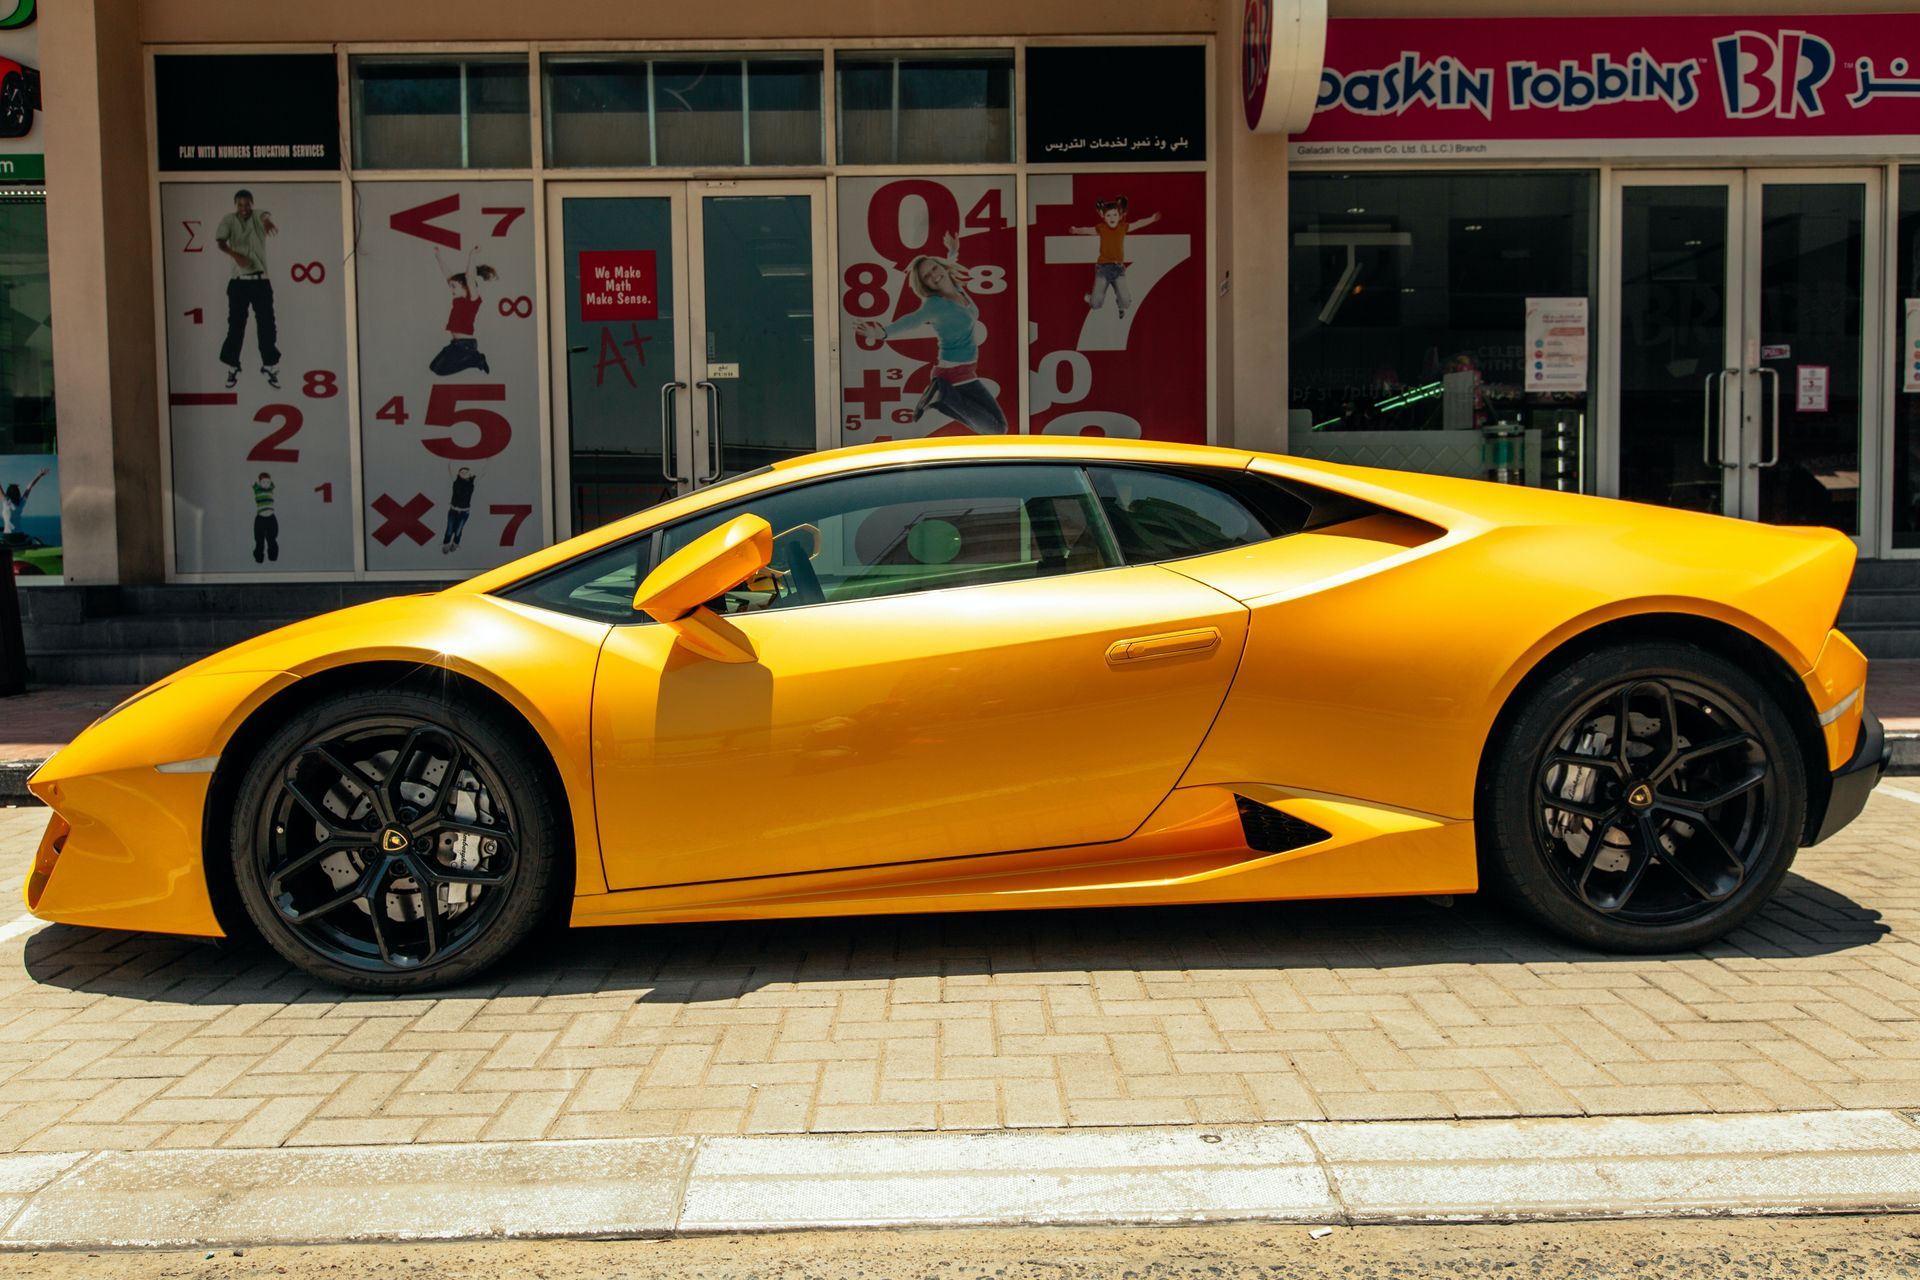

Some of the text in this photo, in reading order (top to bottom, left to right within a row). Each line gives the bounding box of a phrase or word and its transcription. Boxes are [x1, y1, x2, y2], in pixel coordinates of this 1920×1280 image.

[1712, 29, 1835, 119] BR
[179, 144, 325, 158] PLAY WITH NUMBERS EDUCATION SERVICES
[1045, 138, 1086, 151] التدريس
[1089, 137, 1128, 149] لخدمات
[1296, 145, 1335, 155] Galadari
[1337, 145, 1350, 154] Ice
[1352, 145, 1382, 155] Cream
[1384, 145, 1400, 154] Co.
[1402, 144, 1416, 154] Ltd.
[1455, 143, 1487, 153] Branch
[481, 207, 525, 237] 7
[965, 189, 1007, 228] 4
[595, 266, 641, 279] We Make
[605, 280, 631, 291] Math
[967, 265, 1008, 295] 8
[586, 292, 651, 305] Make Sense.
[843, 262, 890, 317] 8
[1044, 234, 1191, 351] 7
[184, 308, 203, 324] 1
[302, 370, 339, 398] 8
[887, 368, 903, 380] 3
[1038, 350, 1092, 404] 0
[376, 396, 409, 425] 4
[421, 384, 512, 460] 5
[845, 415, 862, 431] 5
[246, 404, 304, 463] 2
[314, 482, 333, 503] 1
[489, 504, 532, 547] 7
[460, 831, 471, 869] amborghini
